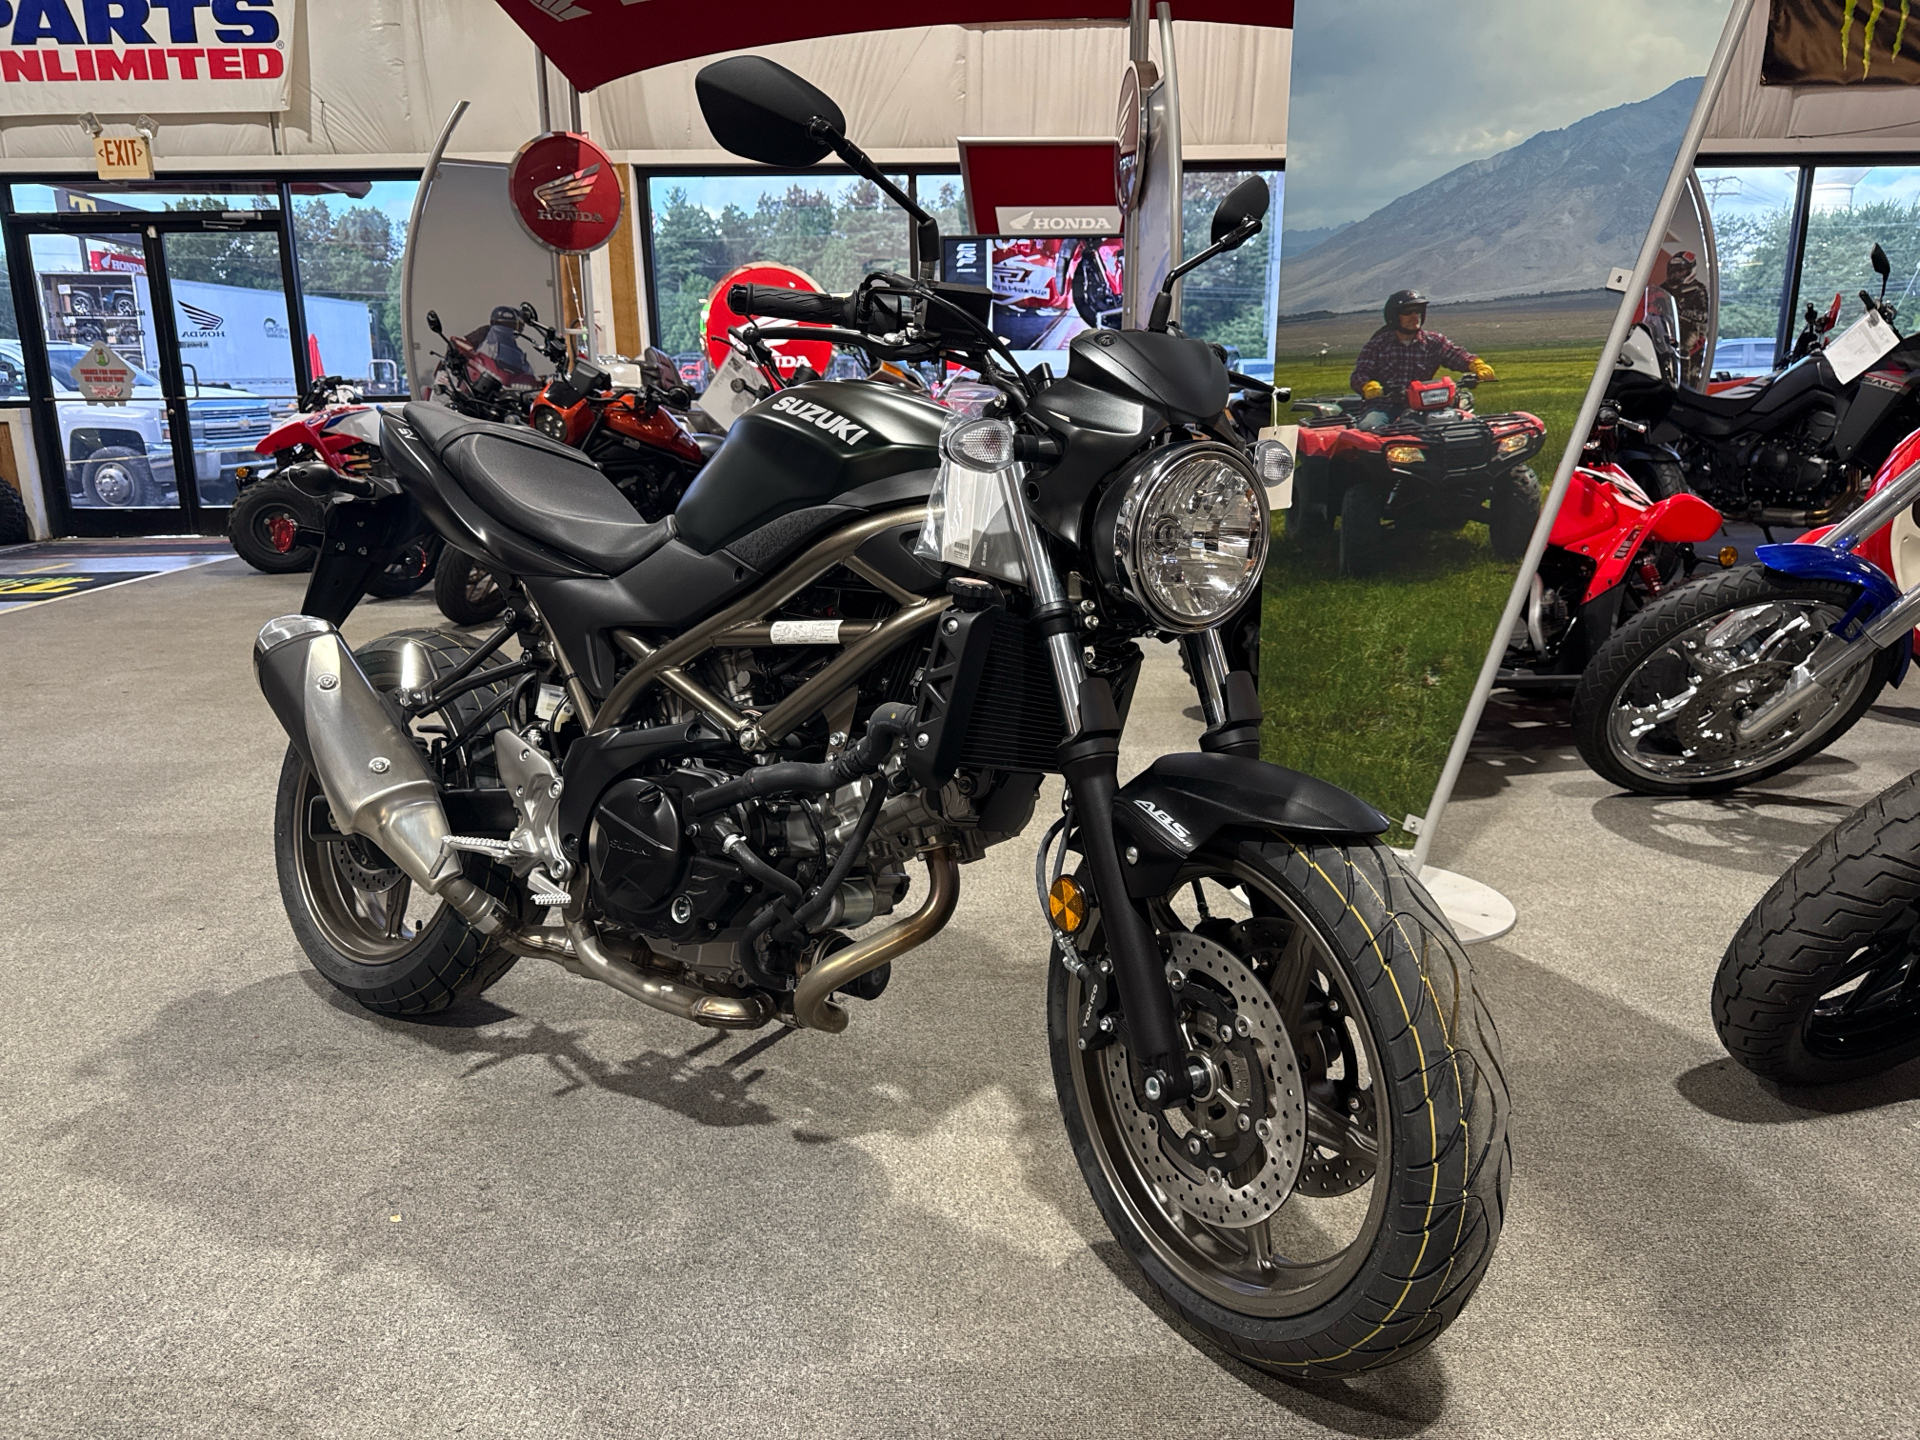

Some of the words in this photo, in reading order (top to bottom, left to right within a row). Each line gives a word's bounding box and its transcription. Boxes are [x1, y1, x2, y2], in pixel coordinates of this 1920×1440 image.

[0, 0, 280, 45] ARTS
[103, 139, 138, 166] EXIT
[537, 209, 605, 223] HONDA
[1033, 217, 1112, 230] HONDA
[111, 260, 146, 274] HONDA
[771, 396, 869, 446] SUZUKI
[1133, 799, 1192, 840] ABS
[1082, 984, 1098, 1028] TOKICO
